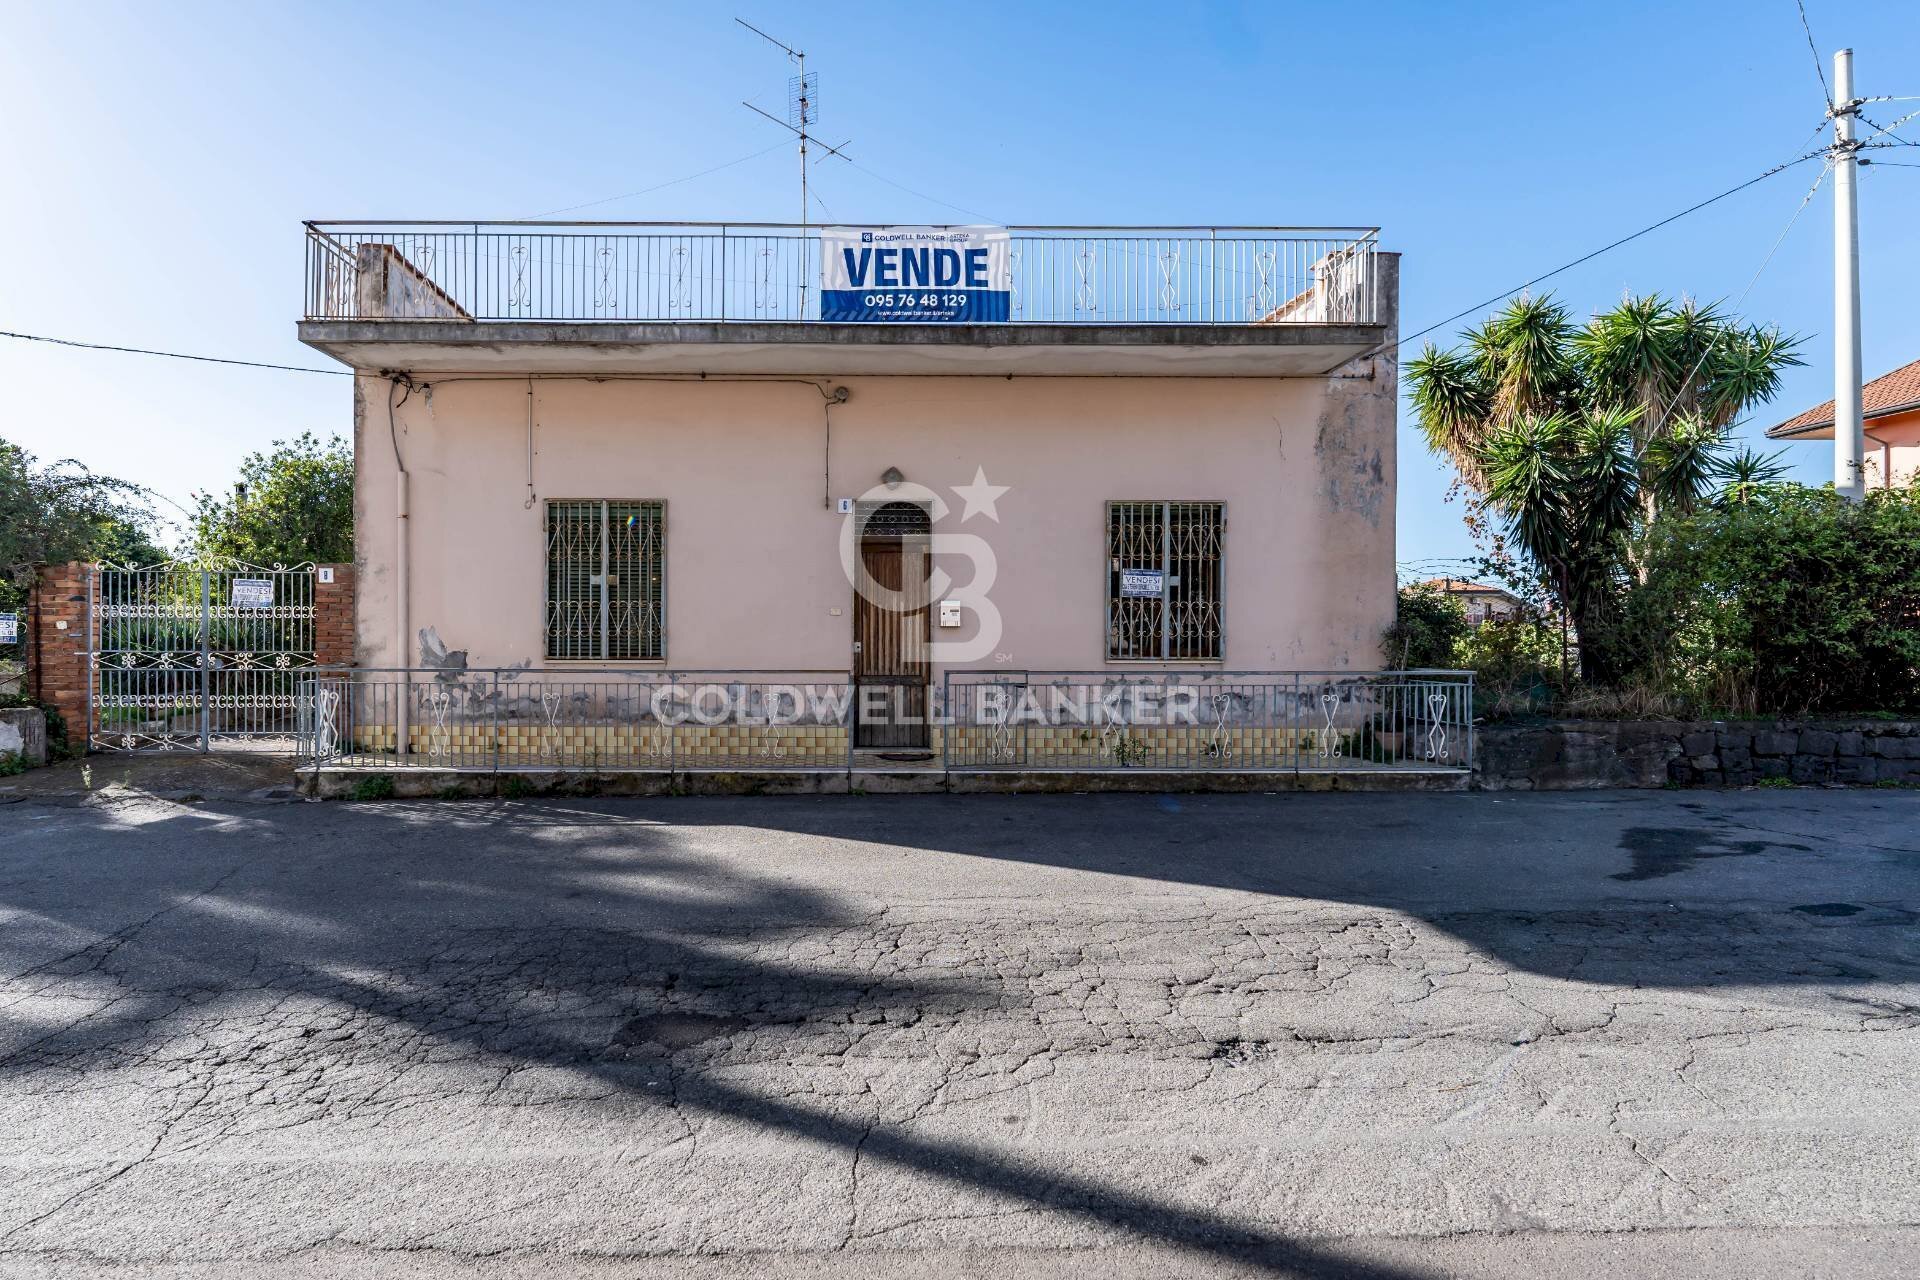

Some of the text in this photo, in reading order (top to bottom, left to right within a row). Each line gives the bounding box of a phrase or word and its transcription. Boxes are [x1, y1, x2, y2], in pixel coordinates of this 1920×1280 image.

[916, 233, 945, 241] BANKER
[843, 248, 989, 287] VENDE
[865, 294, 967, 306] 095 76 48 129
[843, 500, 848, 510] 6
